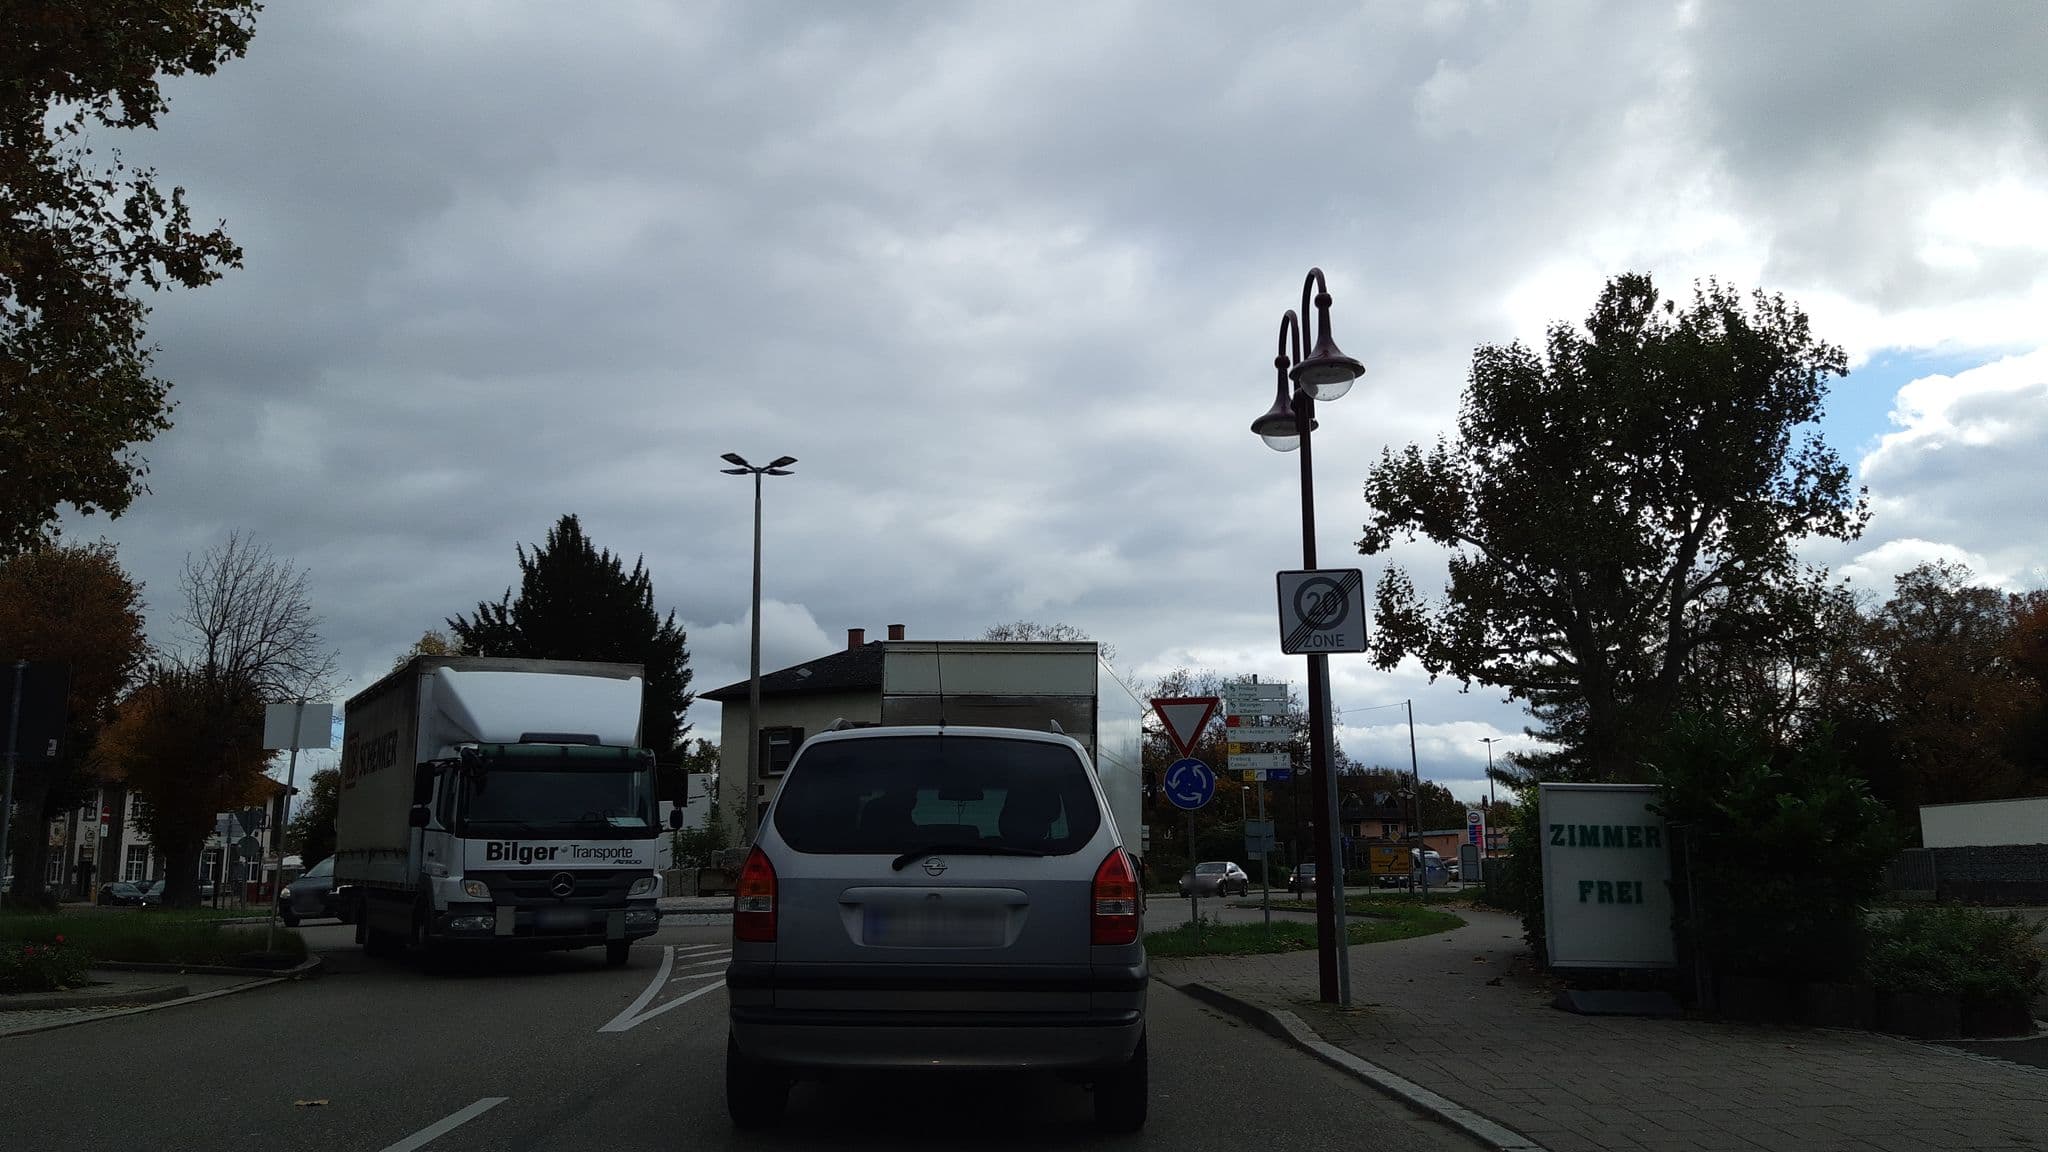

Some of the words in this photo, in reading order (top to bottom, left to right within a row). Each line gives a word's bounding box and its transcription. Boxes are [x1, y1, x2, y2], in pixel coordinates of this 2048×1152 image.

[1304, 634, 1344, 647] ZONE
[358, 730, 397, 776] SCHENKER
[1550, 824, 1662, 848] ZIMMER
[486, 841, 559, 865] Bilger
[571, 845, 633, 860] Transporte
[1579, 880, 1643, 904] FREI
